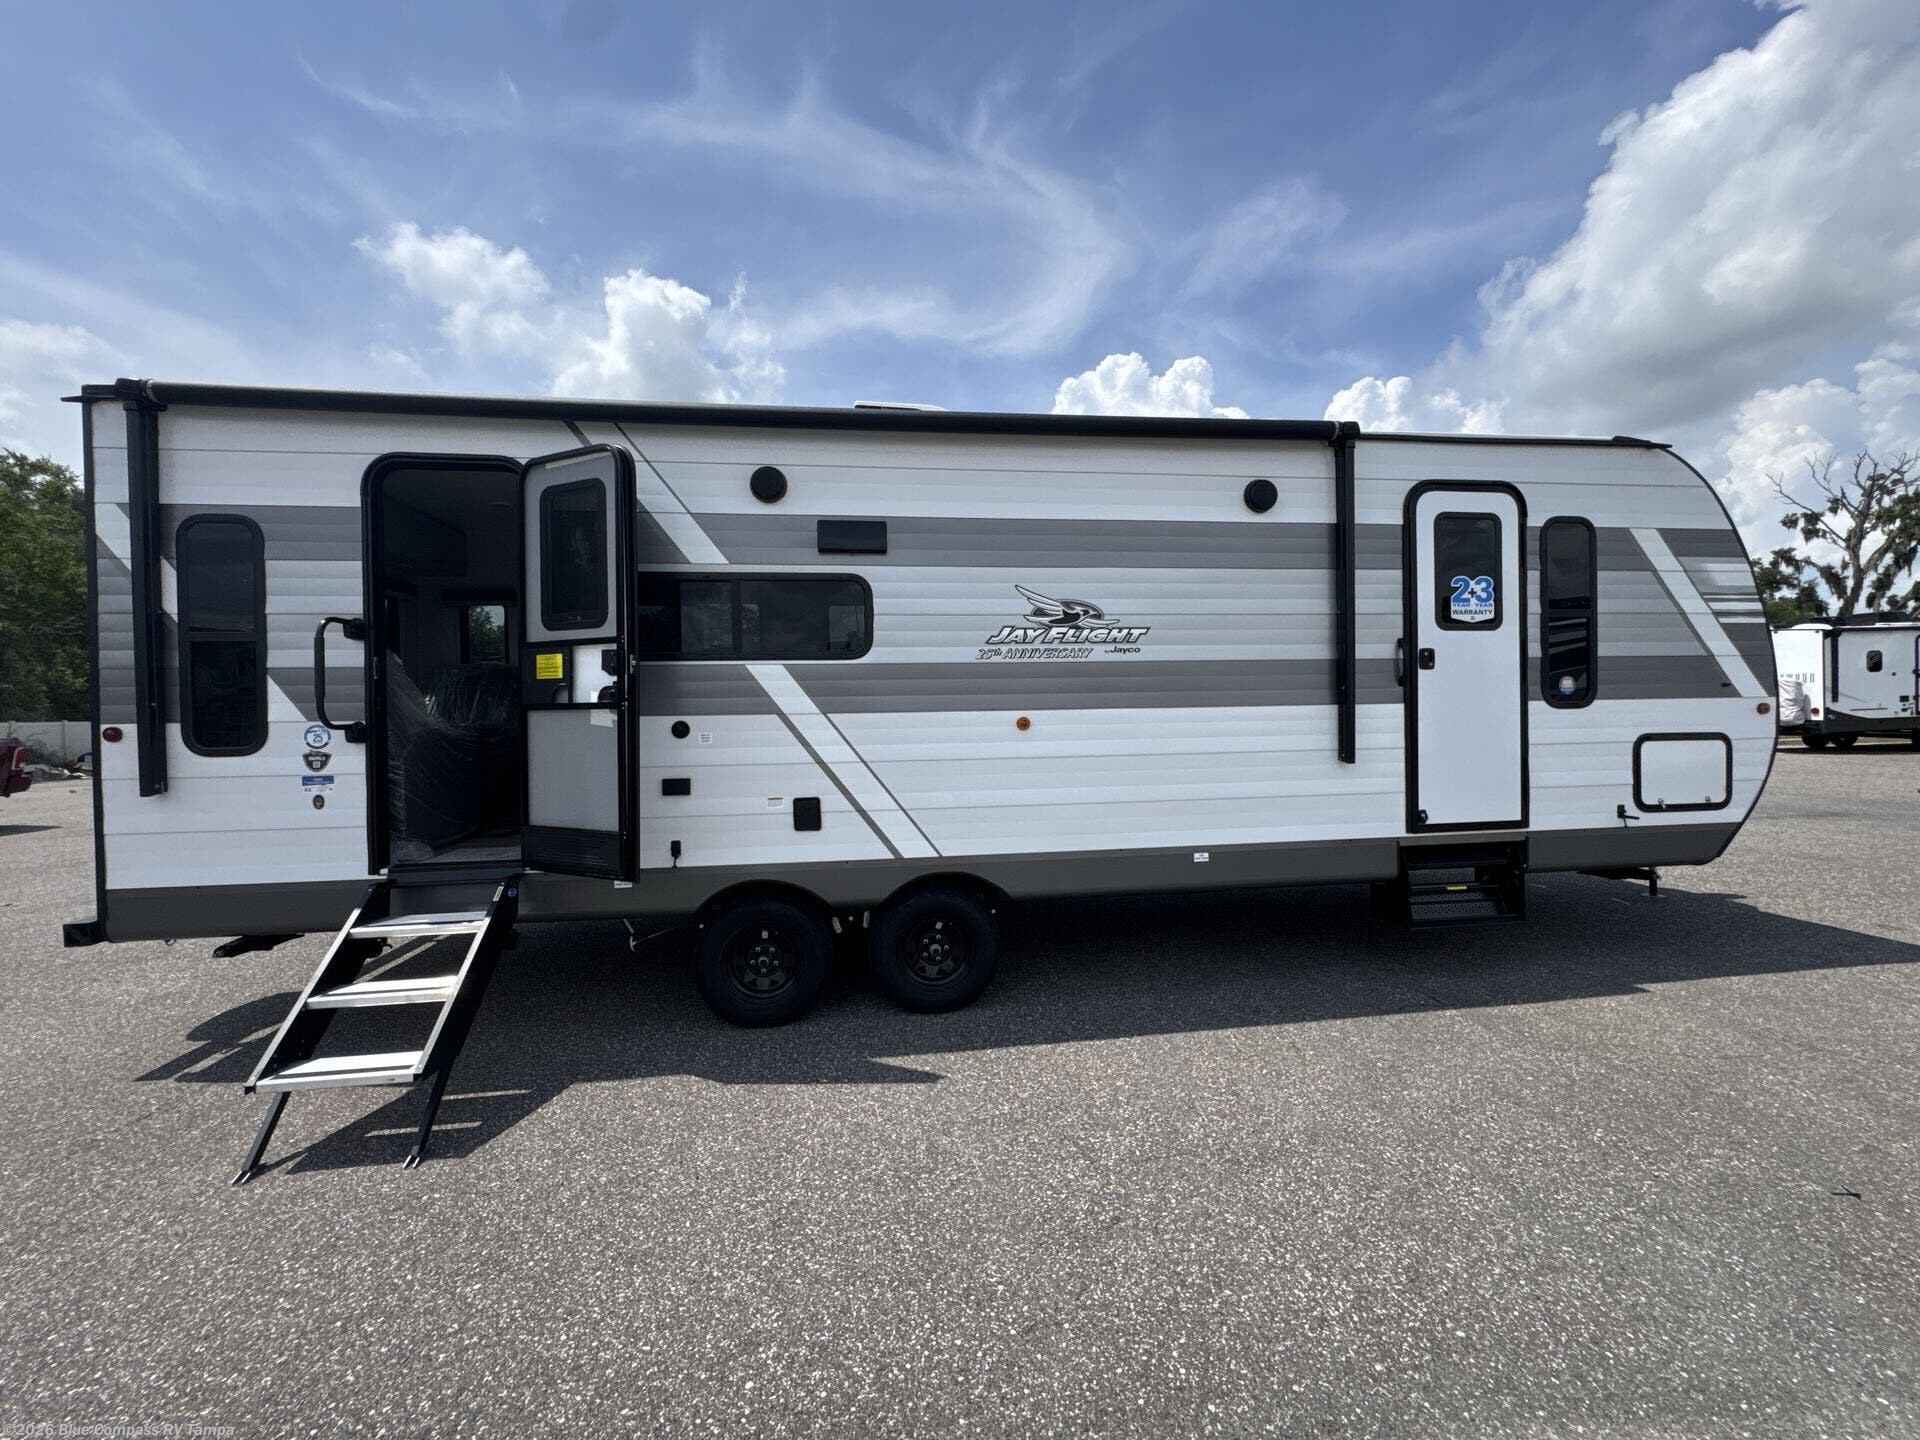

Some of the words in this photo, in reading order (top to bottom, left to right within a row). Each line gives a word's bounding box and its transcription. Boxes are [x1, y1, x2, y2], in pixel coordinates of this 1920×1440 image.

[985, 626, 1047, 645] JAY
[1041, 626, 1151, 645] FLIGHT
[975, 647, 1003, 660] 25th
[1004, 647, 1095, 660] ANNIVERSARY
[1110, 646, 1141, 655] Jayco
